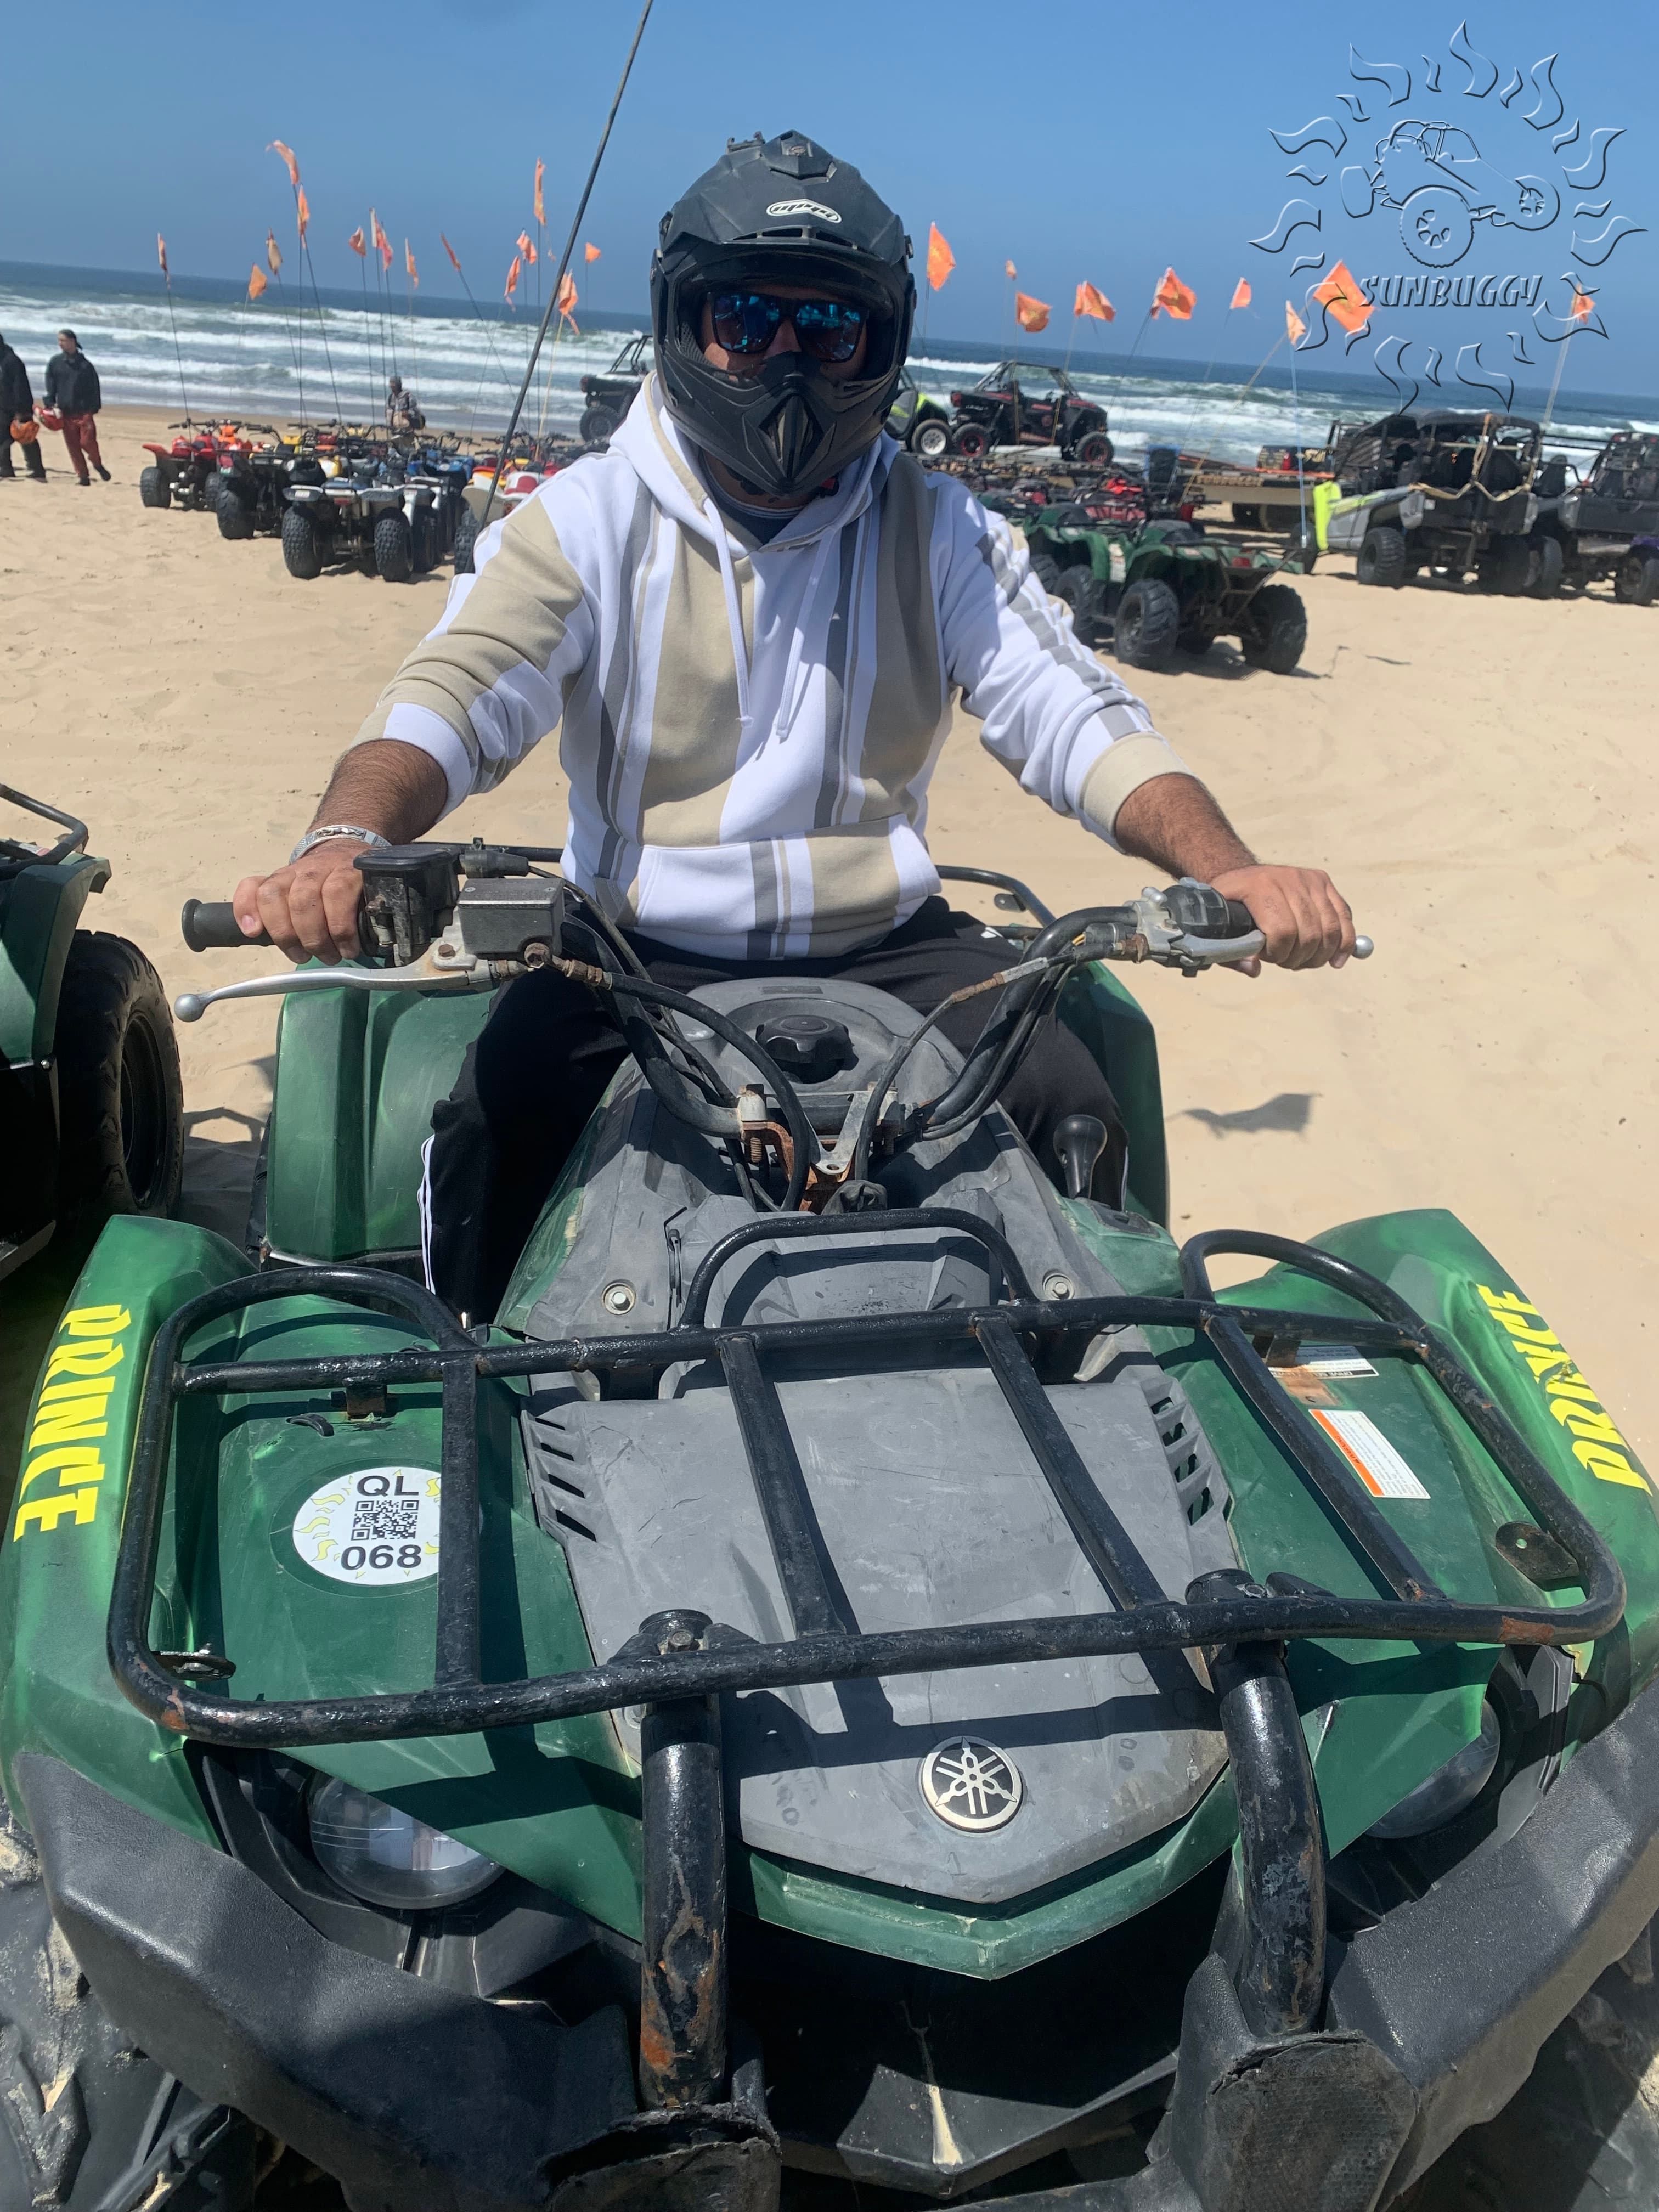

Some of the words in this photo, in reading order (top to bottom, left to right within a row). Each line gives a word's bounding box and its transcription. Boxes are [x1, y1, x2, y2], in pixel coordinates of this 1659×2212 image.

[13, 1304, 132, 1543] PRINCE
[1476, 1283, 1653, 1497] PRINCE
[357, 1475, 419, 1497] QL
[341, 1544, 421, 1576] 068
